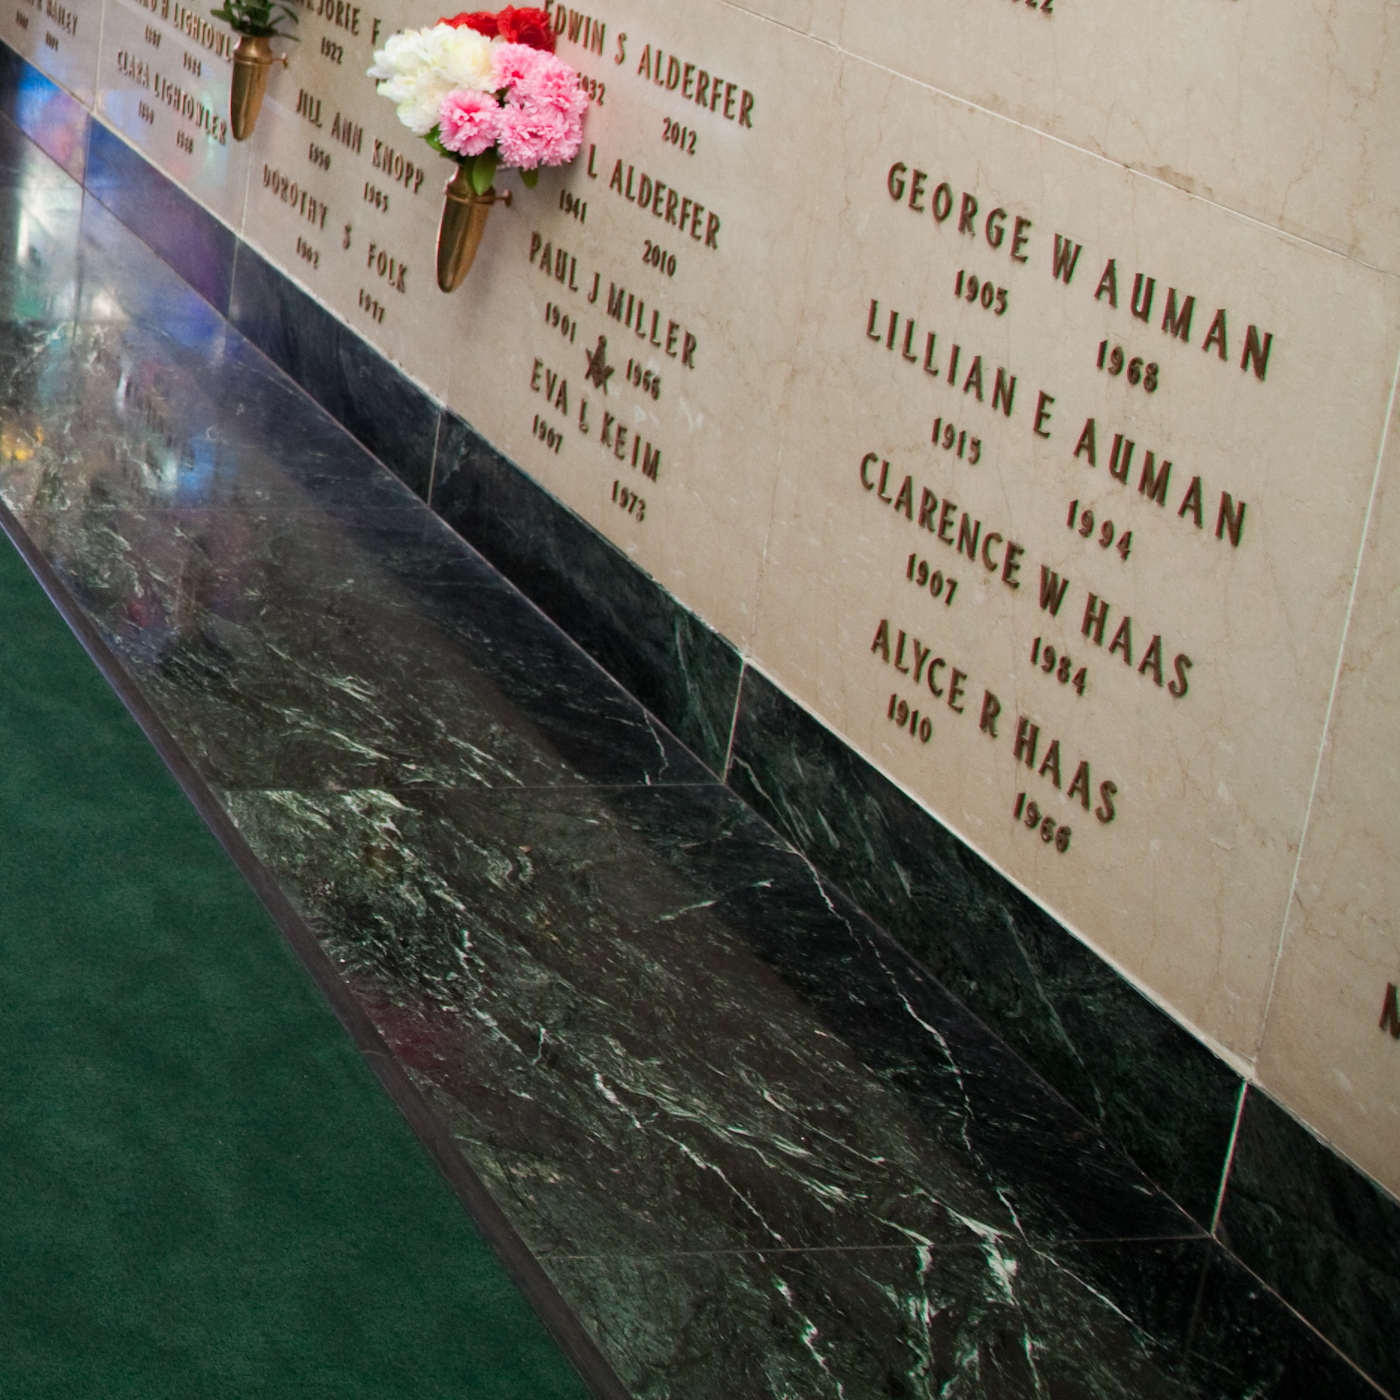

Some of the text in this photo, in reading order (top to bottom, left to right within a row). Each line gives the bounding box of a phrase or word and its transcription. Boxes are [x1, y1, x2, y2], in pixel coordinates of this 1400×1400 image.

[320, 37, 343, 66] 1922
[614, 31, 628, 65] S
[637, 43, 755, 129] ALDERFER
[116, 48, 150, 90] CLARA
[153, 72, 228, 146] LIGHTOWLER
[296, 88, 425, 195] JILL ANN KNOPP
[661, 117, 698, 156] 2012
[558, 188, 588, 225] 1941
[587, 143, 722, 251] L ALDERFER
[263, 163, 408, 294] DOROTHY S FOLK
[642, 239, 678, 278] 2010
[887, 161, 1274, 381] GEORGE W AUMAN
[358, 288, 385, 325] 1977
[529, 230, 698, 370] PAUL J MILLER
[954, 269, 1008, 317] 1905
[545, 301, 578, 344] 1901
[626, 357, 662, 401] 1966
[1096, 339, 1160, 393] 1968
[530, 356, 662, 484] EVA L KEIM
[532, 413, 564, 455] 1907
[866, 299, 1247, 548] LILLIAN E AUMAN
[931, 416, 982, 467] 1915
[612, 479, 647, 523] 1973
[1066, 499, 1133, 561] 1994
[860, 452, 1193, 700] CLARENCE W HAAS
[906, 552, 958, 607] 1907
[1029, 635, 1088, 697] 1984
[870, 618, 1118, 825] ALYCE R HAAS
[886, 692, 933, 745] 1910
[1012, 791, 1071, 854] 1966
